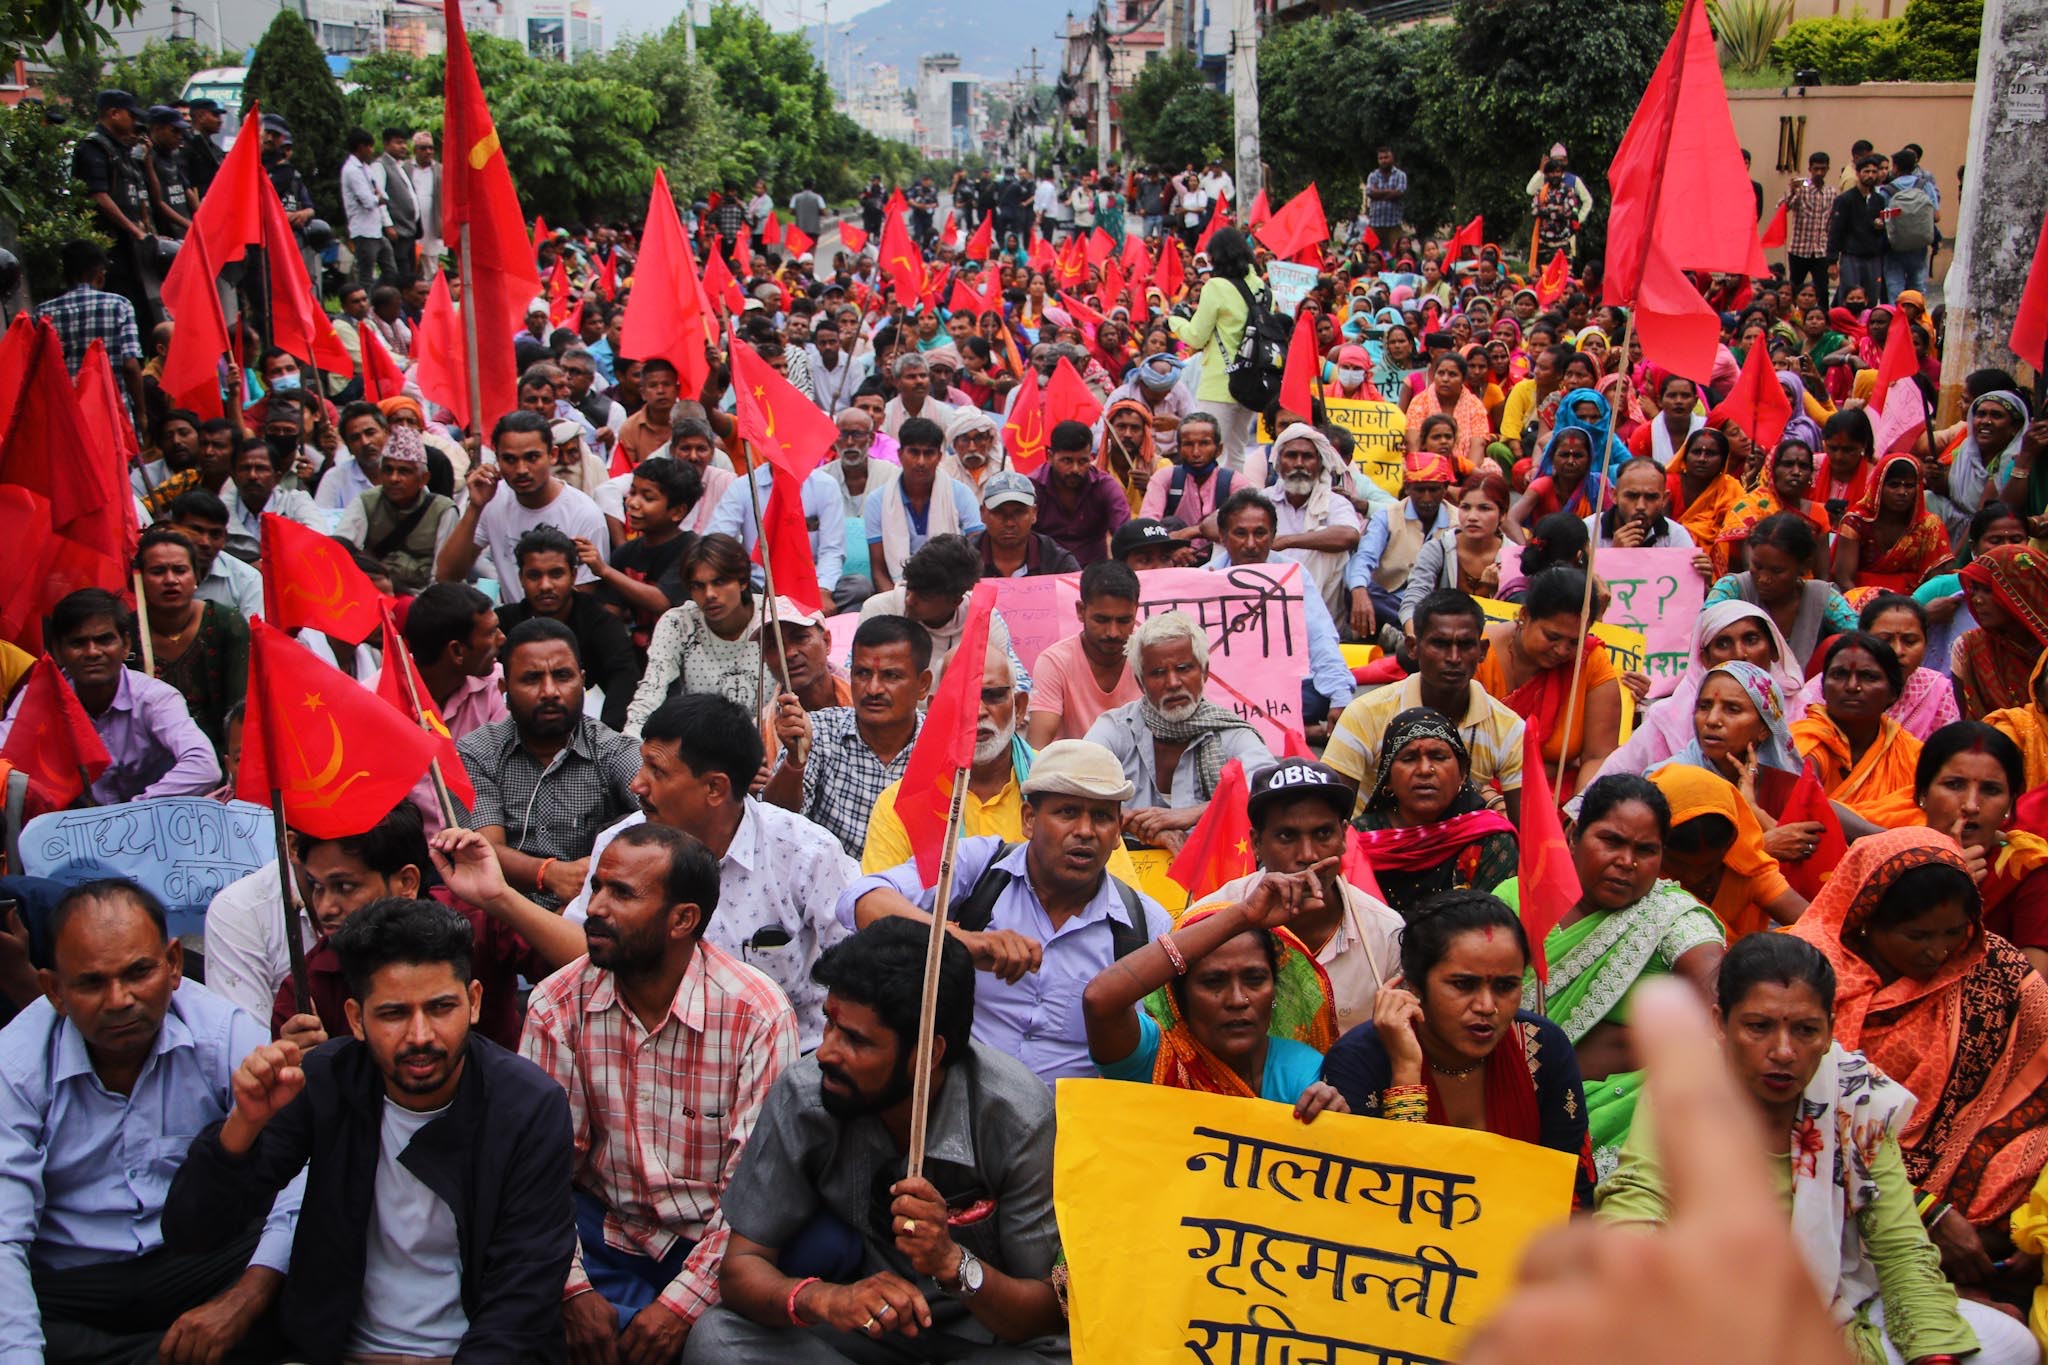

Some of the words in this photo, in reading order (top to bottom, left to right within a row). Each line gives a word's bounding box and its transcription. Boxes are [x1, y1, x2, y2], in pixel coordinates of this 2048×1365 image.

[1269, 765, 1328, 789] OBEY
[1185, 1126, 1482, 1230] नालायक
[1180, 1216, 1478, 1325] गृहमन्त्री
